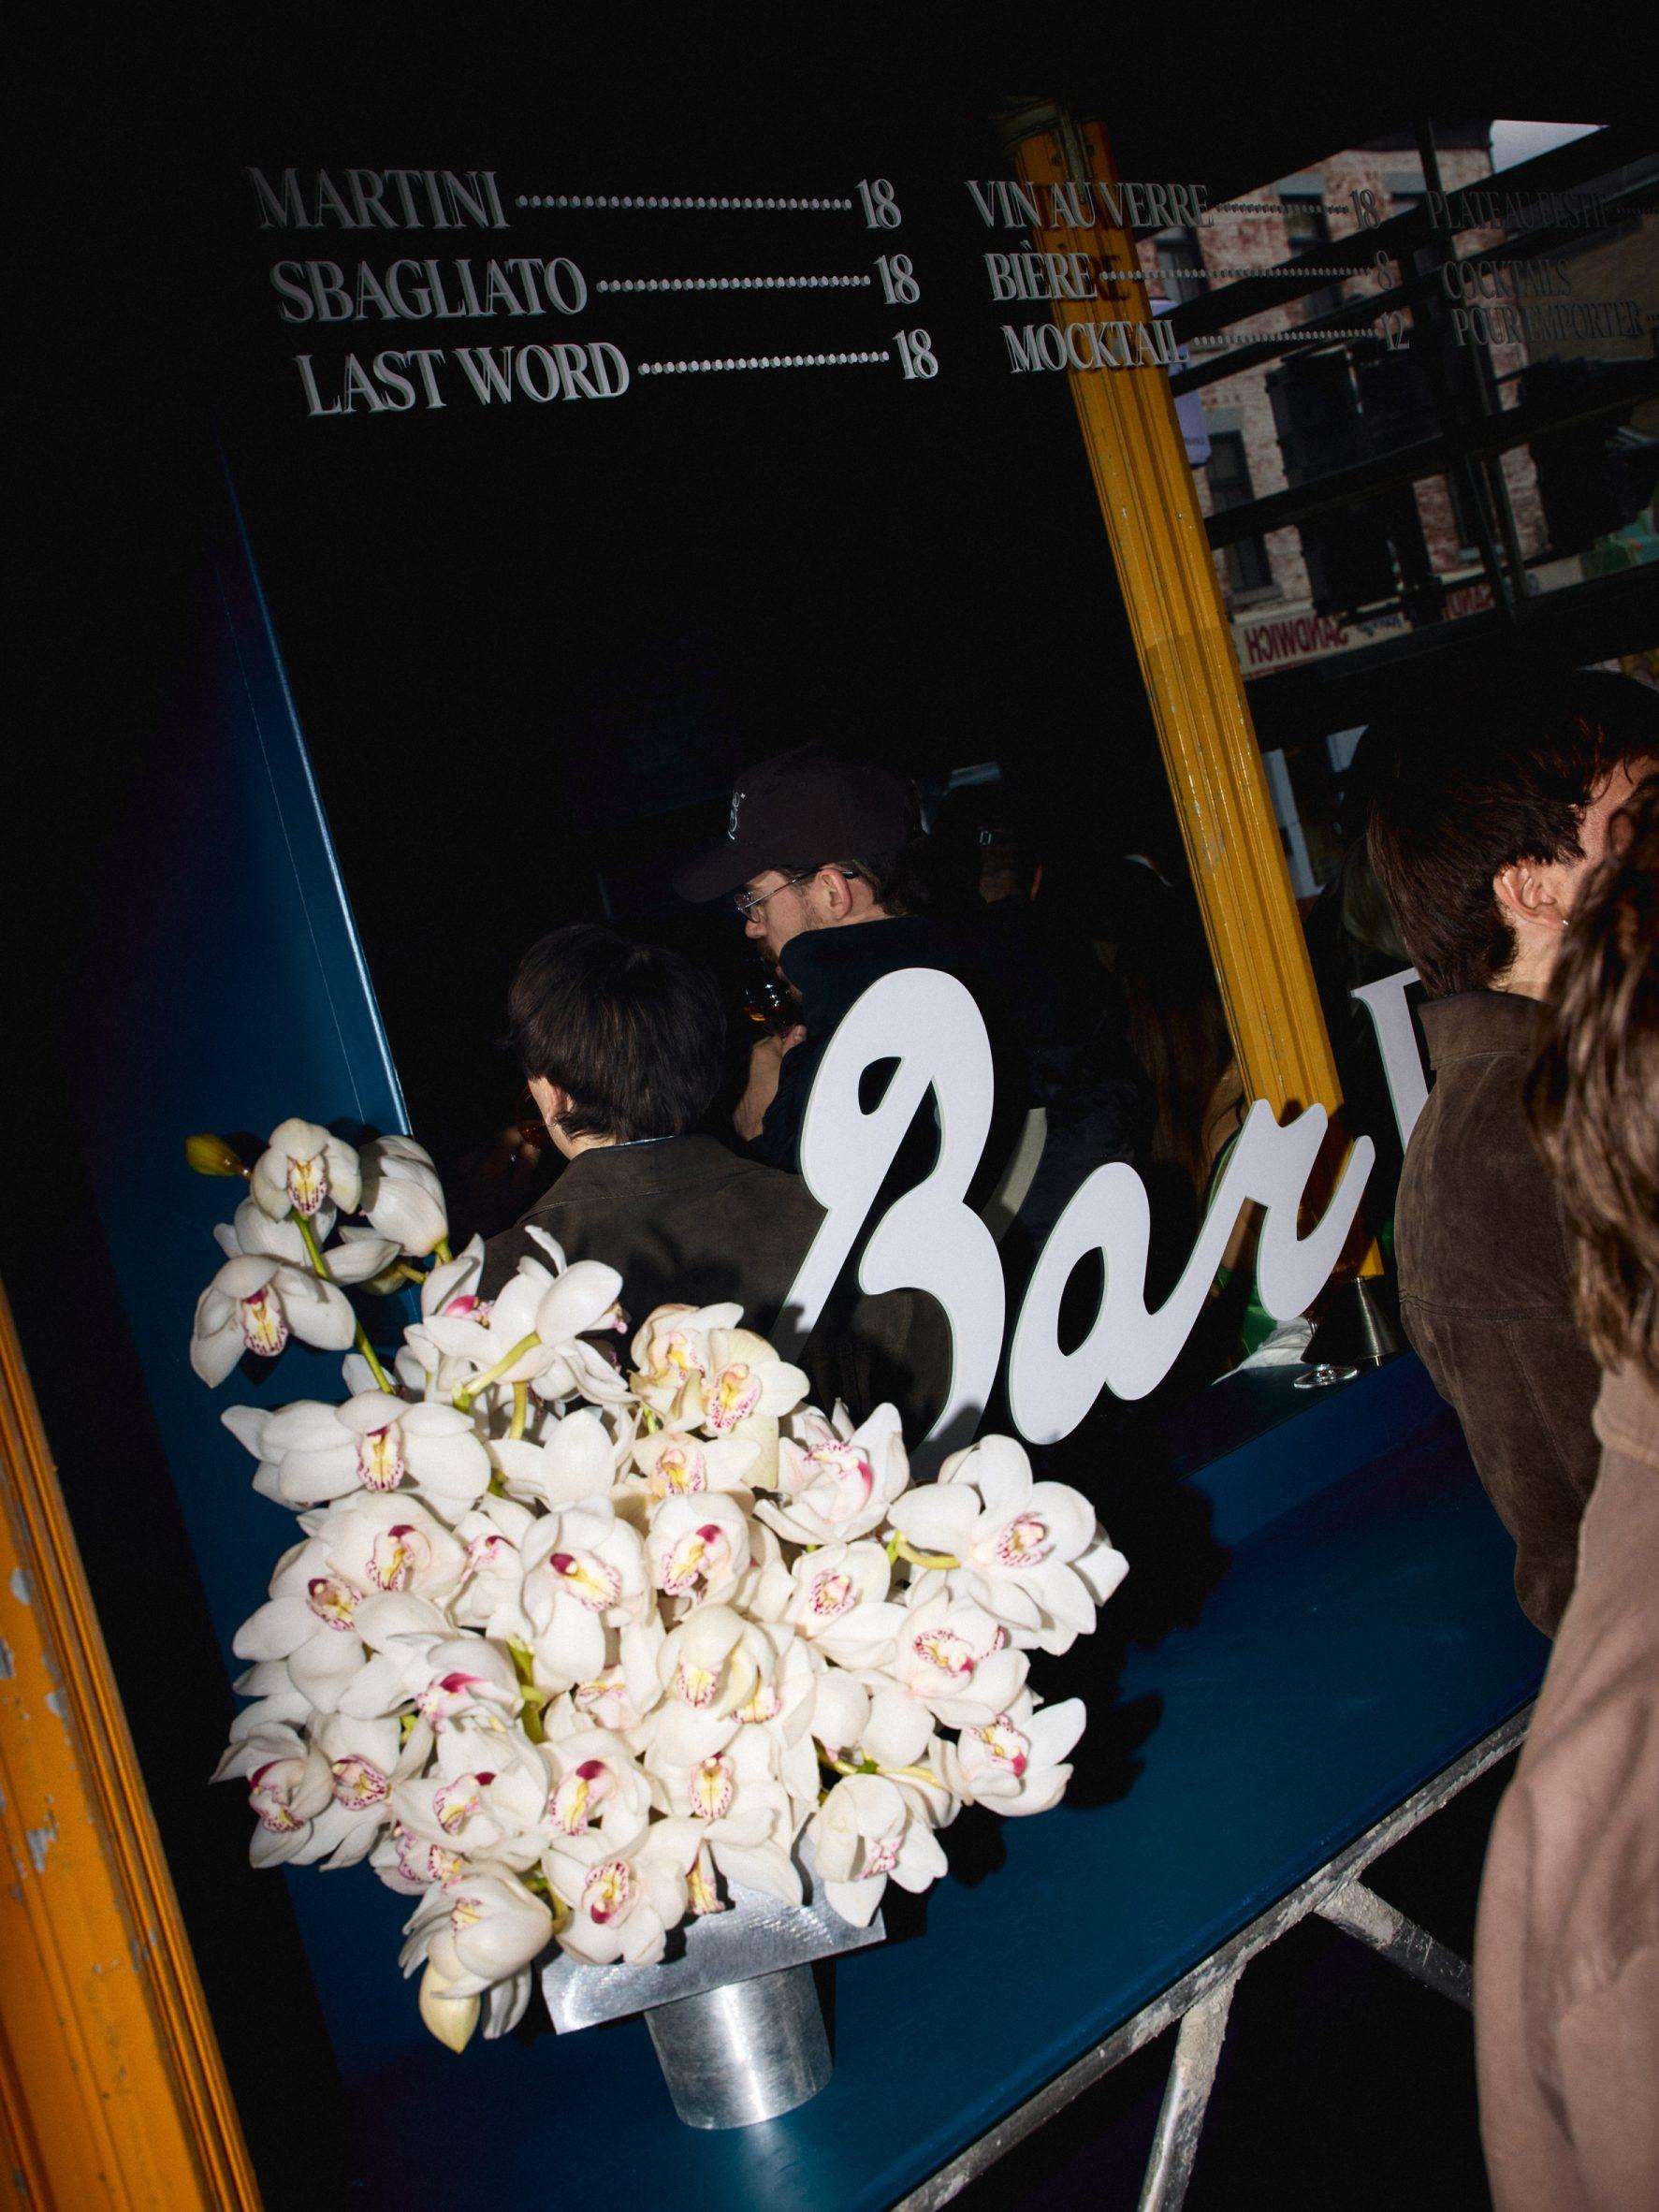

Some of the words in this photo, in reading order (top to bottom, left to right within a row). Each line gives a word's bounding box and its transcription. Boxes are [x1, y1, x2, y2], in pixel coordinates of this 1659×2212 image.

[246, 166, 512, 230] MARTINI
[855, 178, 903, 230] 18
[964, 180, 1042, 229] VIN
[1049, 182, 1098, 229] AU
[1098, 182, 1215, 229] VERRE
[1347, 189, 1382, 230] 18
[1424, 190, 1535, 230] PLATEAU
[269, 257, 589, 324] SBAGLIATO
[874, 254, 921, 306] 18
[982, 240, 1099, 302] BIÈRE
[1373, 250, 1395, 291] 8
[1441, 258, 1573, 301] COCKTAILS
[999, 319, 1190, 375] MOCKTAIL
[1377, 310, 1411, 353] 12
[1450, 305, 1522, 347] POUR
[1521, 298, 1644, 344] EMPORTER
[292, 348, 447, 417] LAST
[451, 341, 631, 405] WORD
[891, 327, 939, 382] 18
[767, 967, 1376, 1486] Bar
